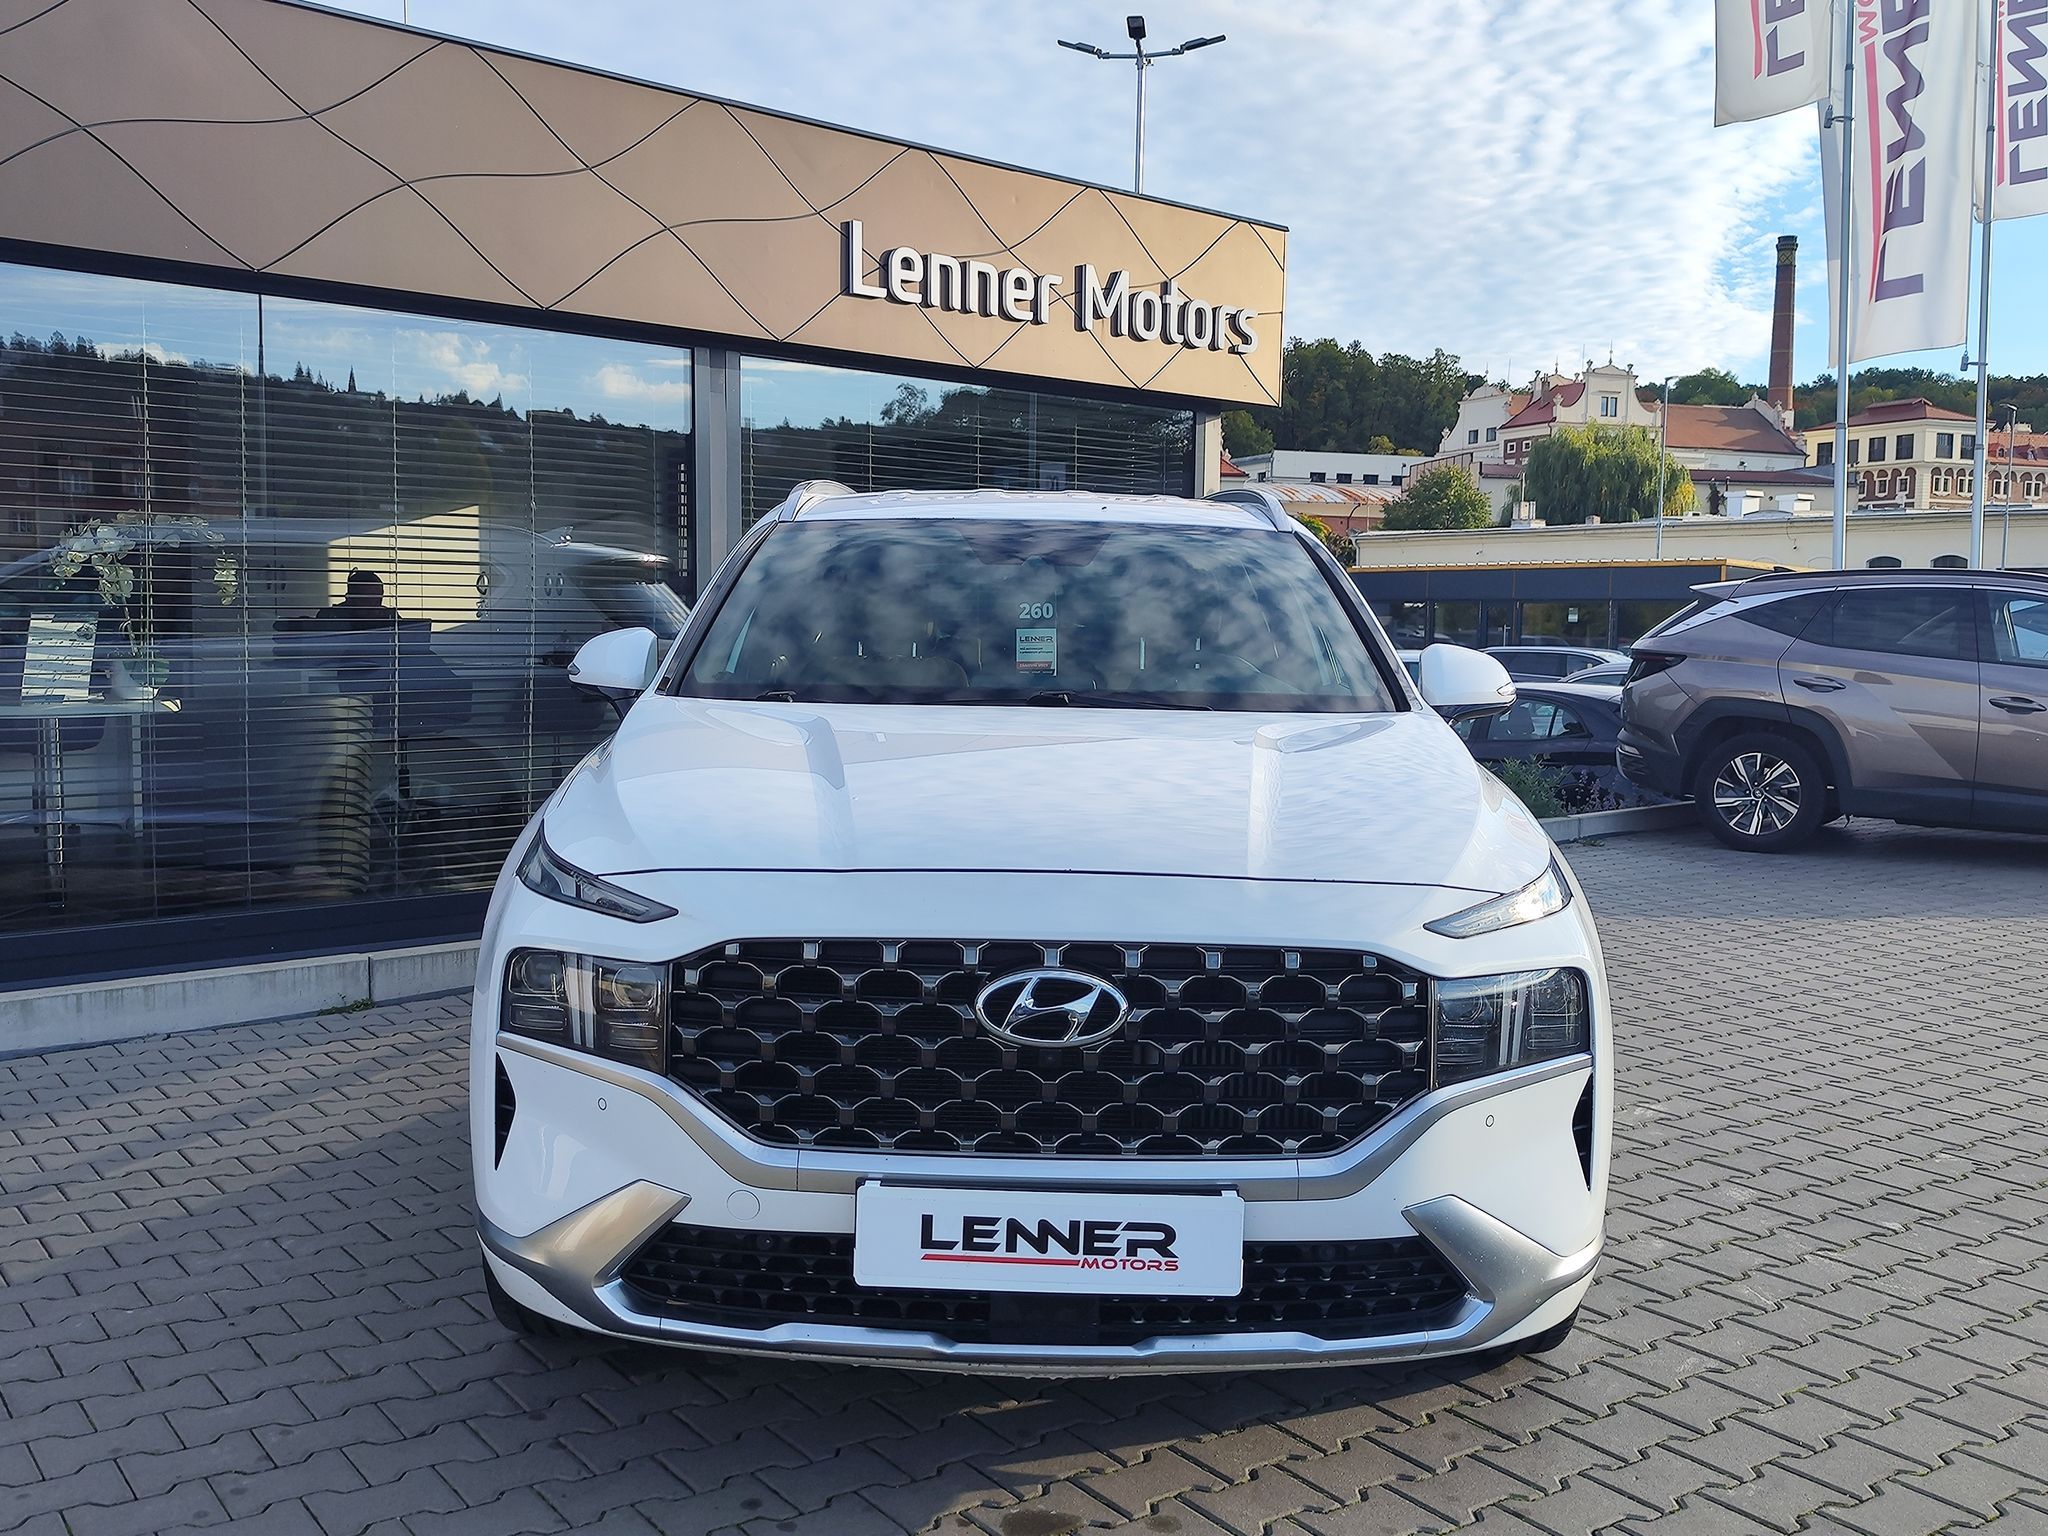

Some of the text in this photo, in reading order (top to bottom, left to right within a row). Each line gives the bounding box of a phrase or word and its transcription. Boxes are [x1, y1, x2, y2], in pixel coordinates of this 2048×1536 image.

[841, 219, 1259, 354] Lenner Motors
[1019, 602, 1054, 619] 260
[920, 1213, 1179, 1259] LENNER
[1080, 1257, 1179, 1272] MOTORS
